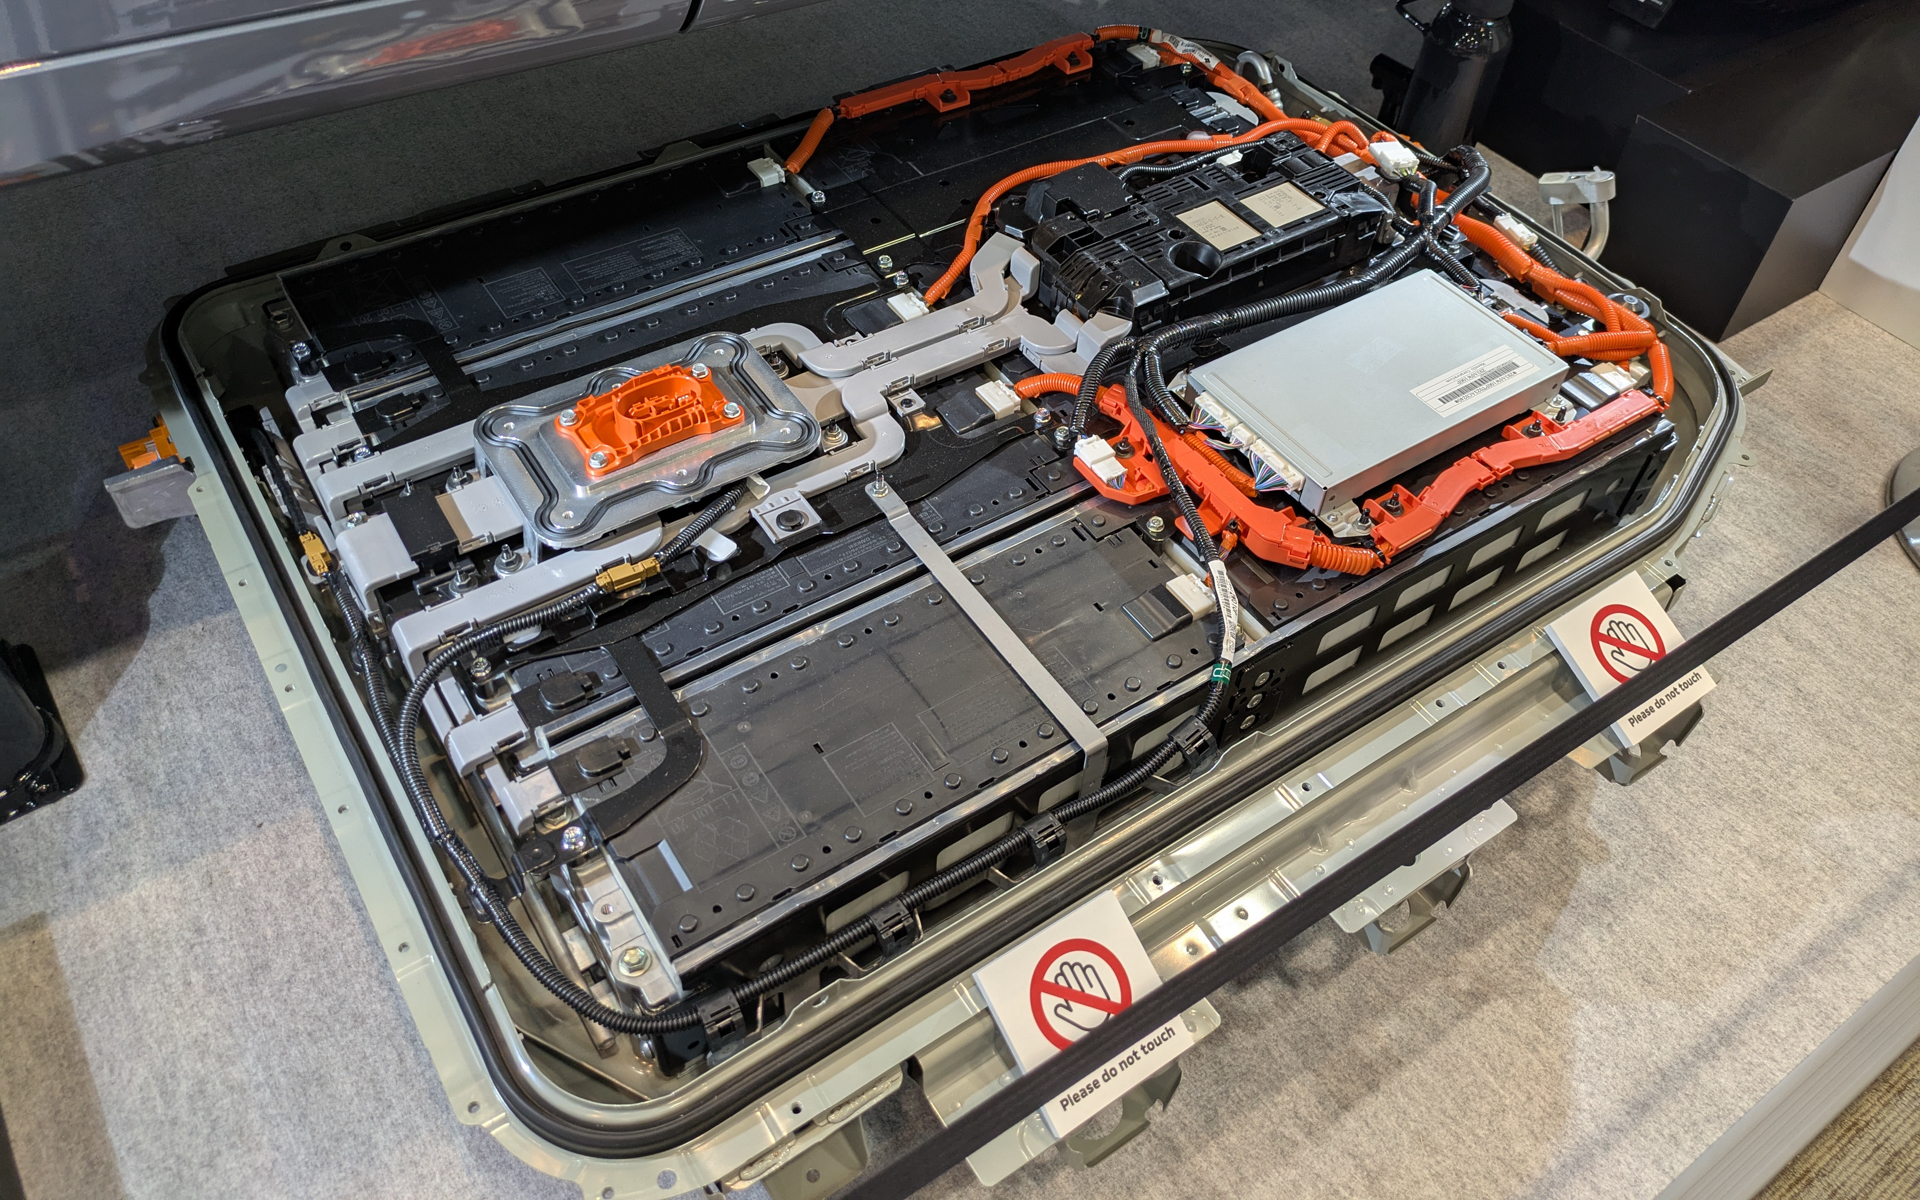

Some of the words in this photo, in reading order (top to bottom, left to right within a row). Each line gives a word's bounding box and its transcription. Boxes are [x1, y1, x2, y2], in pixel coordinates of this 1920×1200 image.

[1627, 705, 1655, 727] Please
[1655, 698, 1666, 709] do
[1666, 687, 1681, 702] not
[1679, 672, 1702, 692] touch
[1059, 1079, 1101, 1112] Please
[1102, 1068, 1118, 1083] do
[1118, 1049, 1141, 1072] not
[1140, 1026, 1176, 1055] touch
